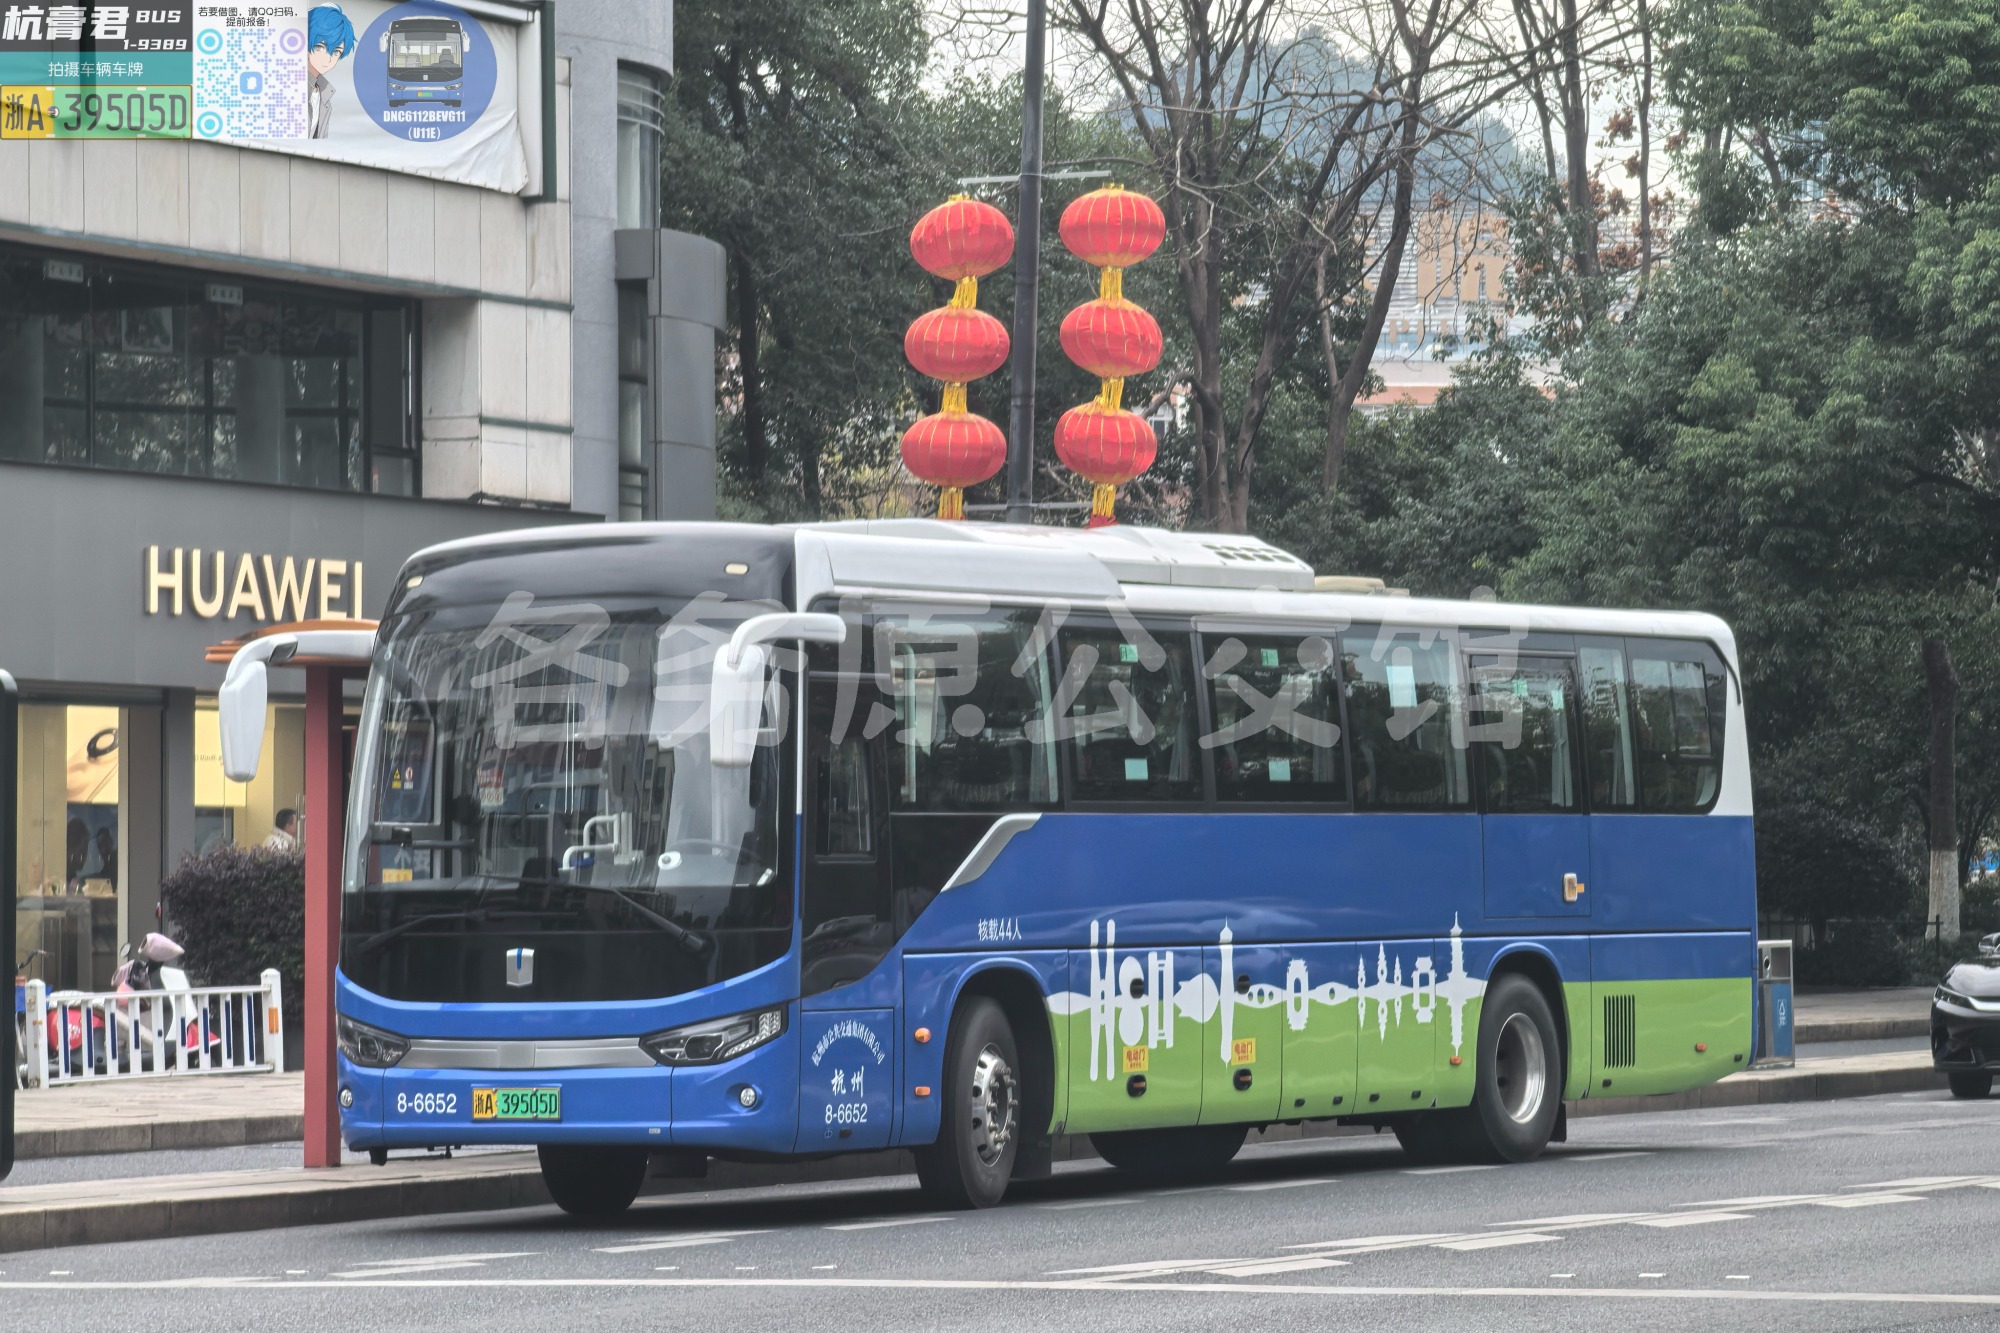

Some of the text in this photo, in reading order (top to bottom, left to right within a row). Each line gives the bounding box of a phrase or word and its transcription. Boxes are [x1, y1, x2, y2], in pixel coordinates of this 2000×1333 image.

[146, 545, 363, 622] HUAWEI
[978, 917, 1022, 942] 核载44人
[831, 1065, 865, 1099] 杭州
[397, 1092, 457, 1114] 8-6652
[825, 1102, 868, 1124] 8-6652
